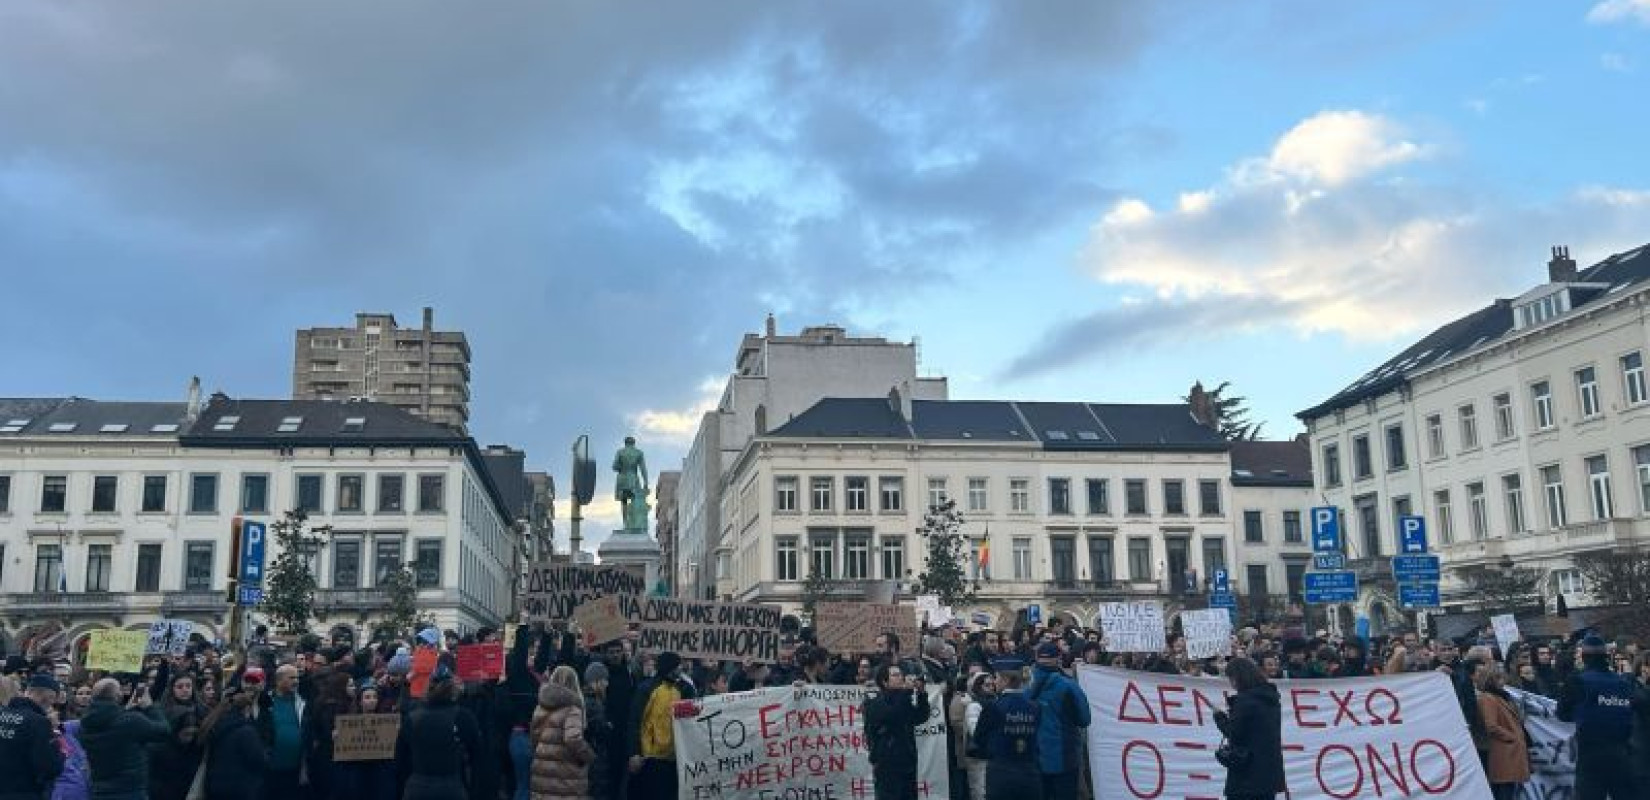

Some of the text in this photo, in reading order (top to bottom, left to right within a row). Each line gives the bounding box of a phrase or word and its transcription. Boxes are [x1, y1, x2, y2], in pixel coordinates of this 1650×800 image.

[1317, 510, 1333, 534] P
[1405, 519, 1420, 538] P
[247, 525, 261, 556] P
[530, 566, 560, 593] ΔΕΝ
[1216, 570, 1224, 585] P
[736, 630, 779, 661] ΟΡΓΗ
[1290, 688, 1403, 727] ΕΧΩ
[697, 702, 866, 755] ΤΟ ΕΓΚΛΗΜ
[684, 760, 709, 784] ΝΑ
[717, 748, 754, 773] ΜΗΝ
[736, 754, 846, 790] ΝΕΚΡΩΝ
